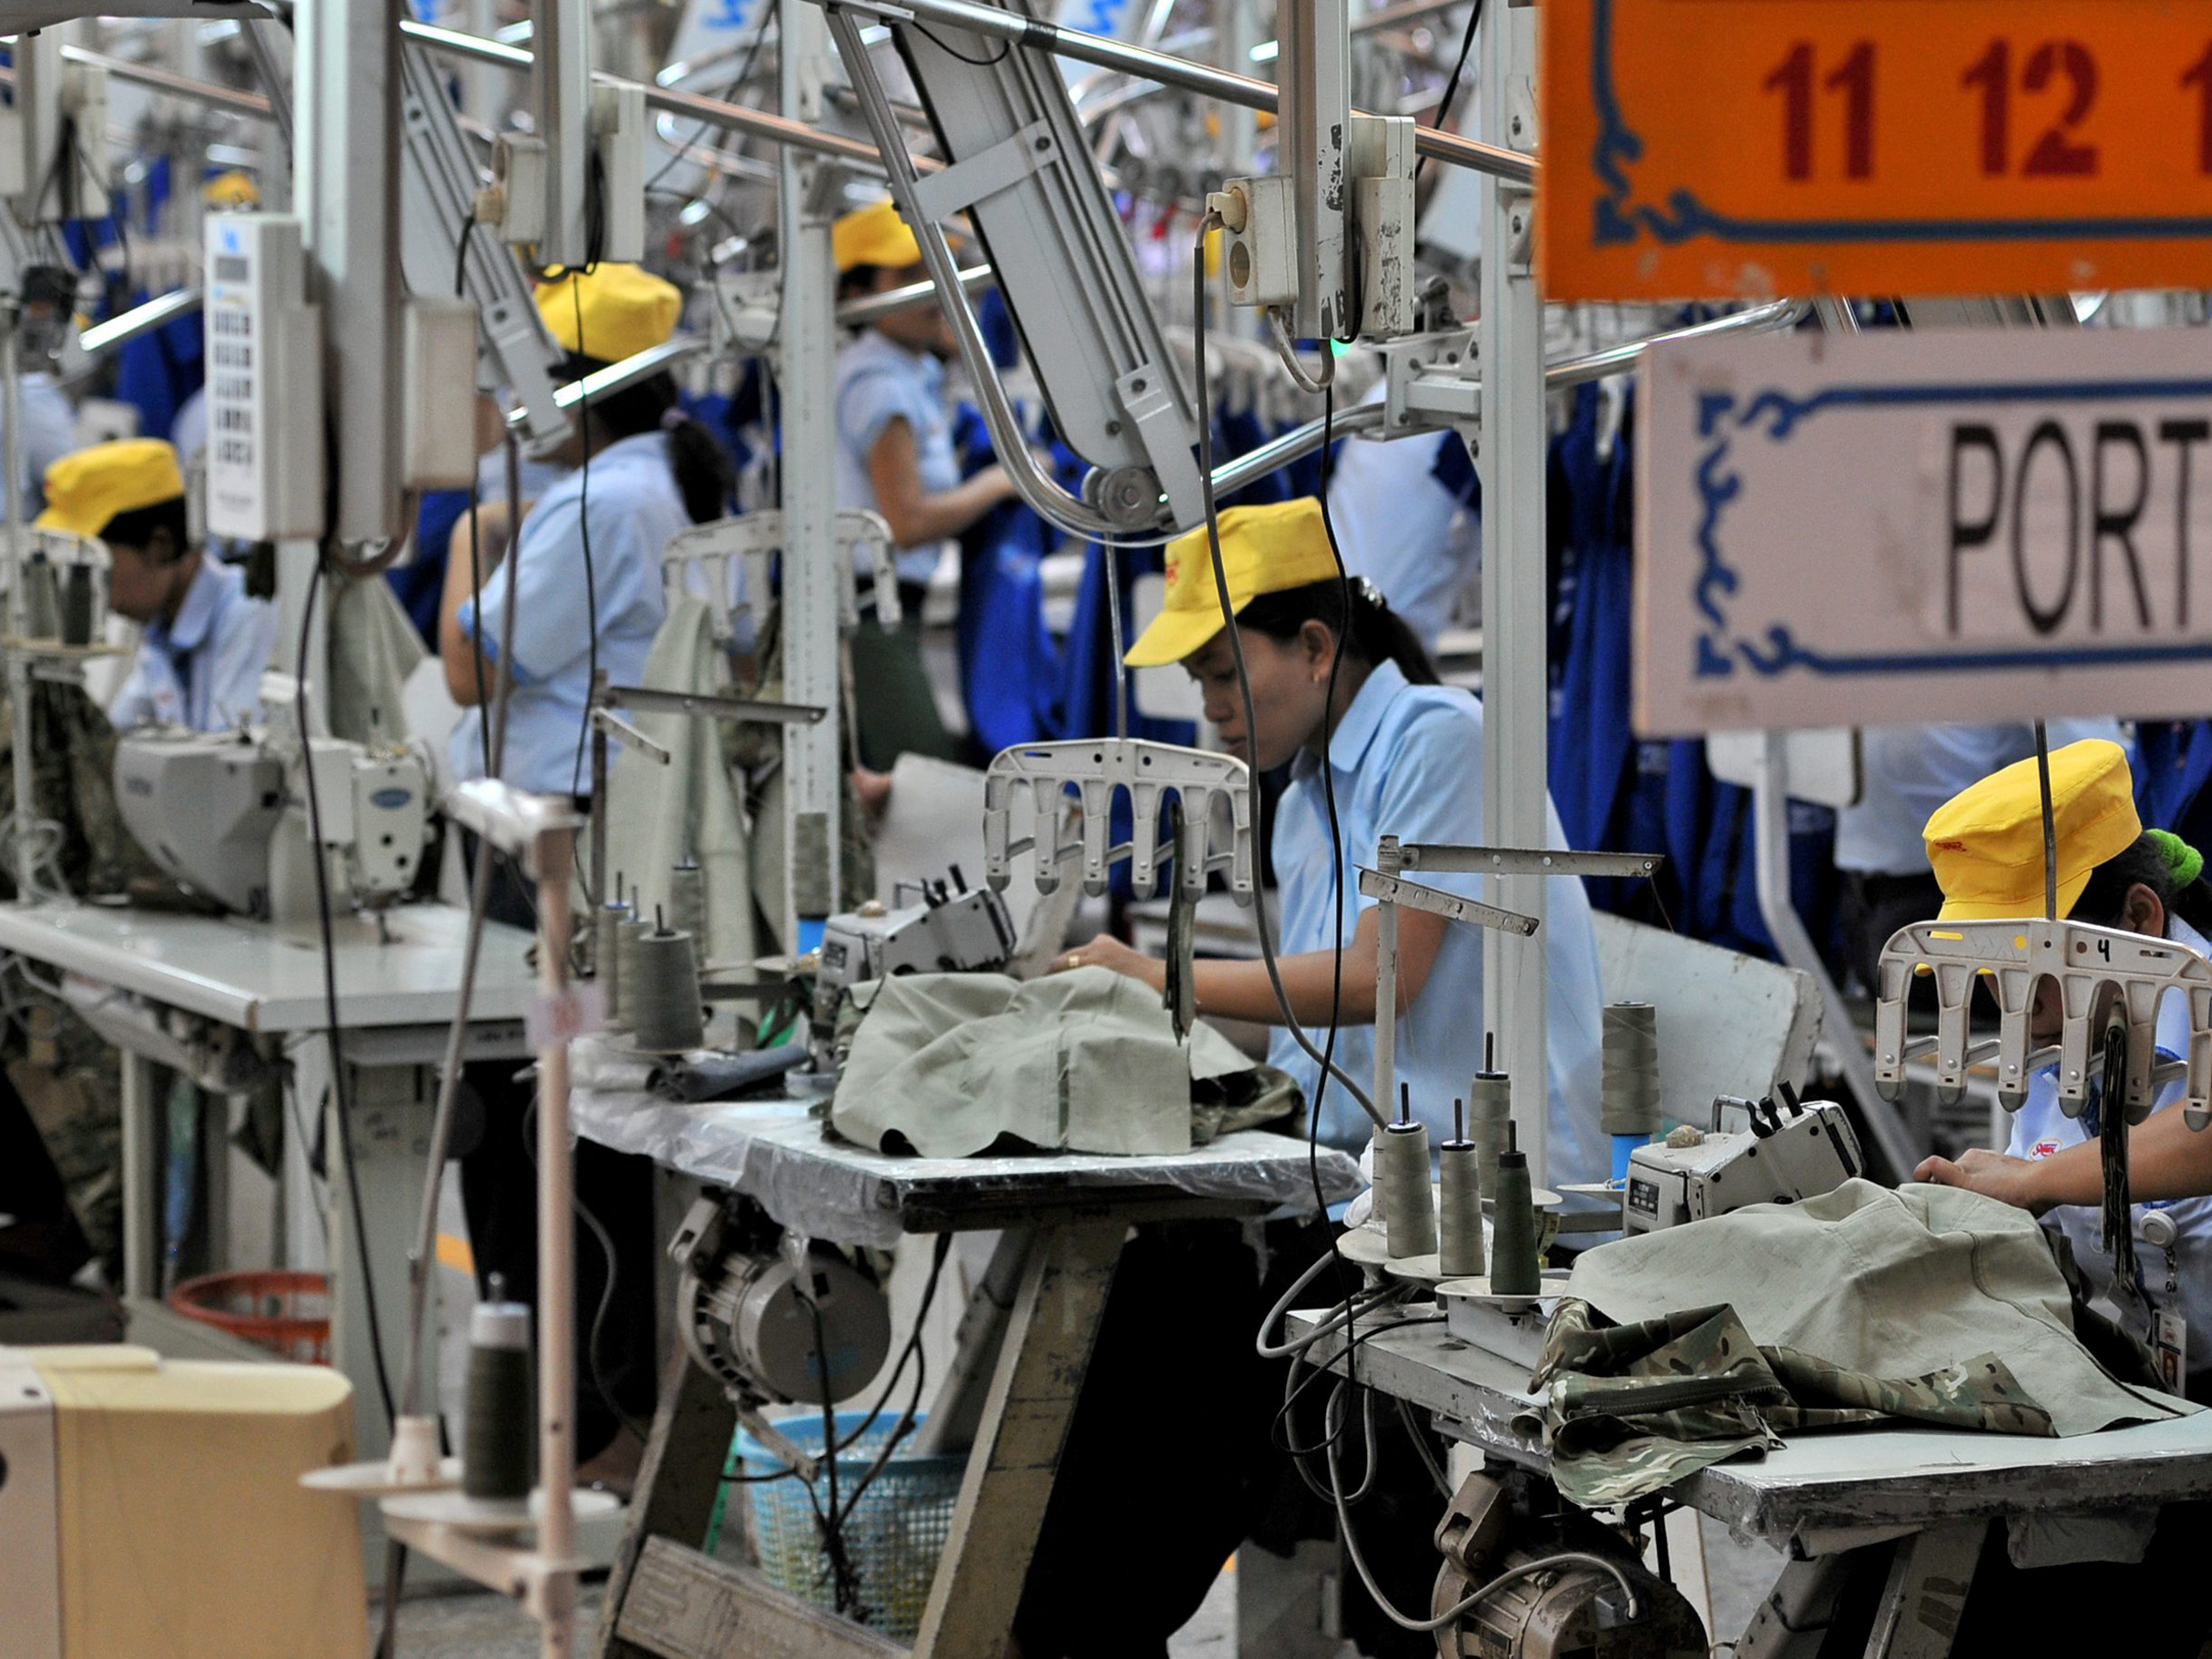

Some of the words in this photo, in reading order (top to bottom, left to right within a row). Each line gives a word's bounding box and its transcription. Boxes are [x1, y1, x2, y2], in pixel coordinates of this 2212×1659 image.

[1763, 38, 1878, 183] 11
[1961, 37, 2098, 178] 12
[1945, 415, 2212, 639] PORT
[2097, 939, 2110, 962] 4
